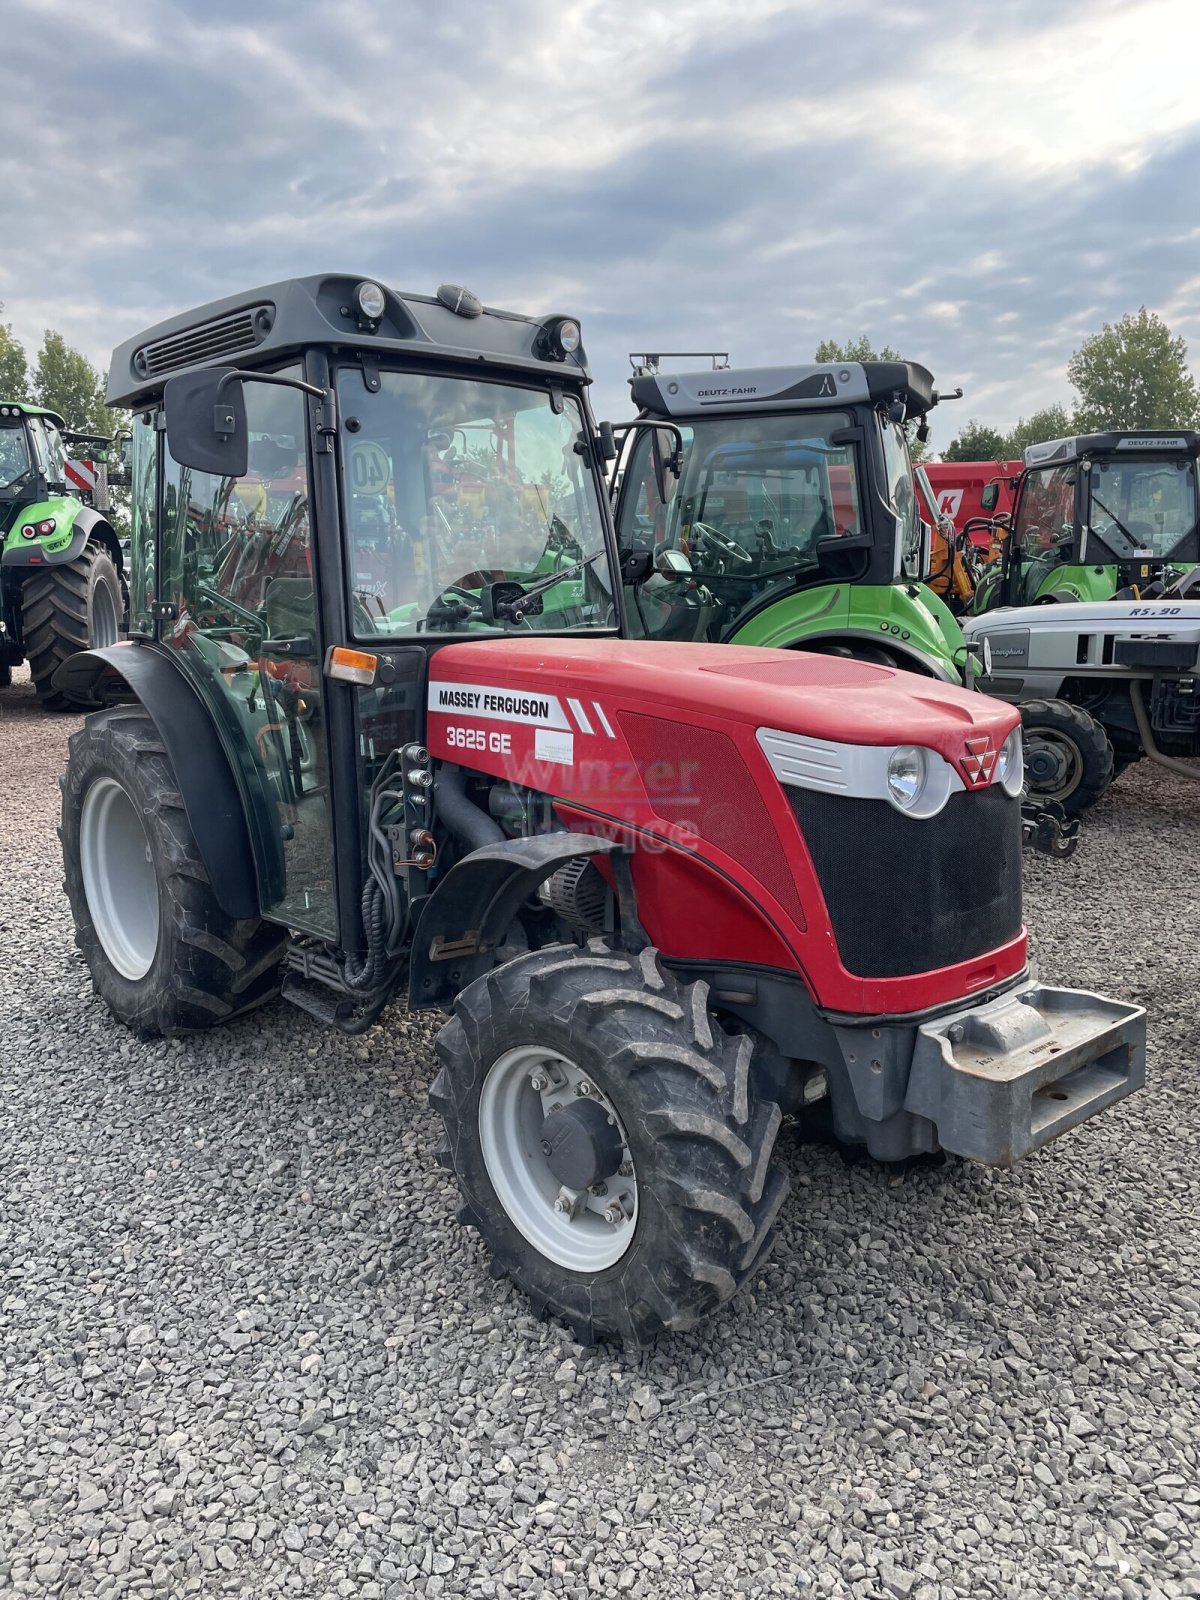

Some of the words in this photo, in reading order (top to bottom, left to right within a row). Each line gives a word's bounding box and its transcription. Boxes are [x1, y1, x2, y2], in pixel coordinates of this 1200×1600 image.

[697, 387, 757, 397] DEUTZ-FAHR
[941, 496, 957, 514] K
[439, 690, 480, 709] MASSEY
[484, 694, 549, 718] FERGUSON
[446, 726, 486, 751] 3625
[489, 732, 512, 755] GE
